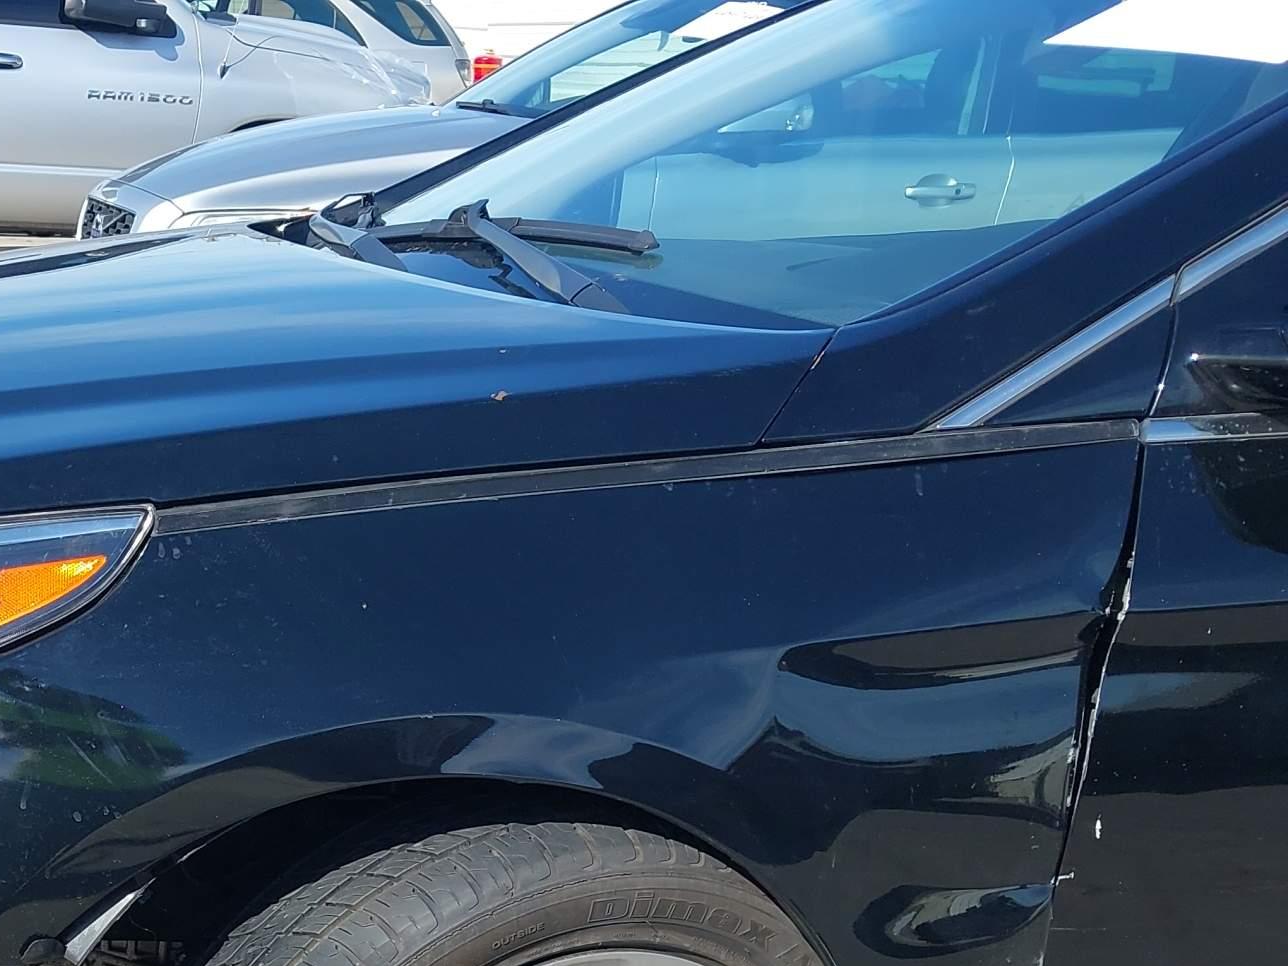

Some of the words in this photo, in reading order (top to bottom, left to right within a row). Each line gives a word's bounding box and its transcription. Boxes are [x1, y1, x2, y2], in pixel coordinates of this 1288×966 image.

[87, 89, 134, 101] RAM
[139, 91, 193, 105] 1500
[587, 889, 777, 951] Dimax
[491, 922, 545, 950] OUTSIDE
